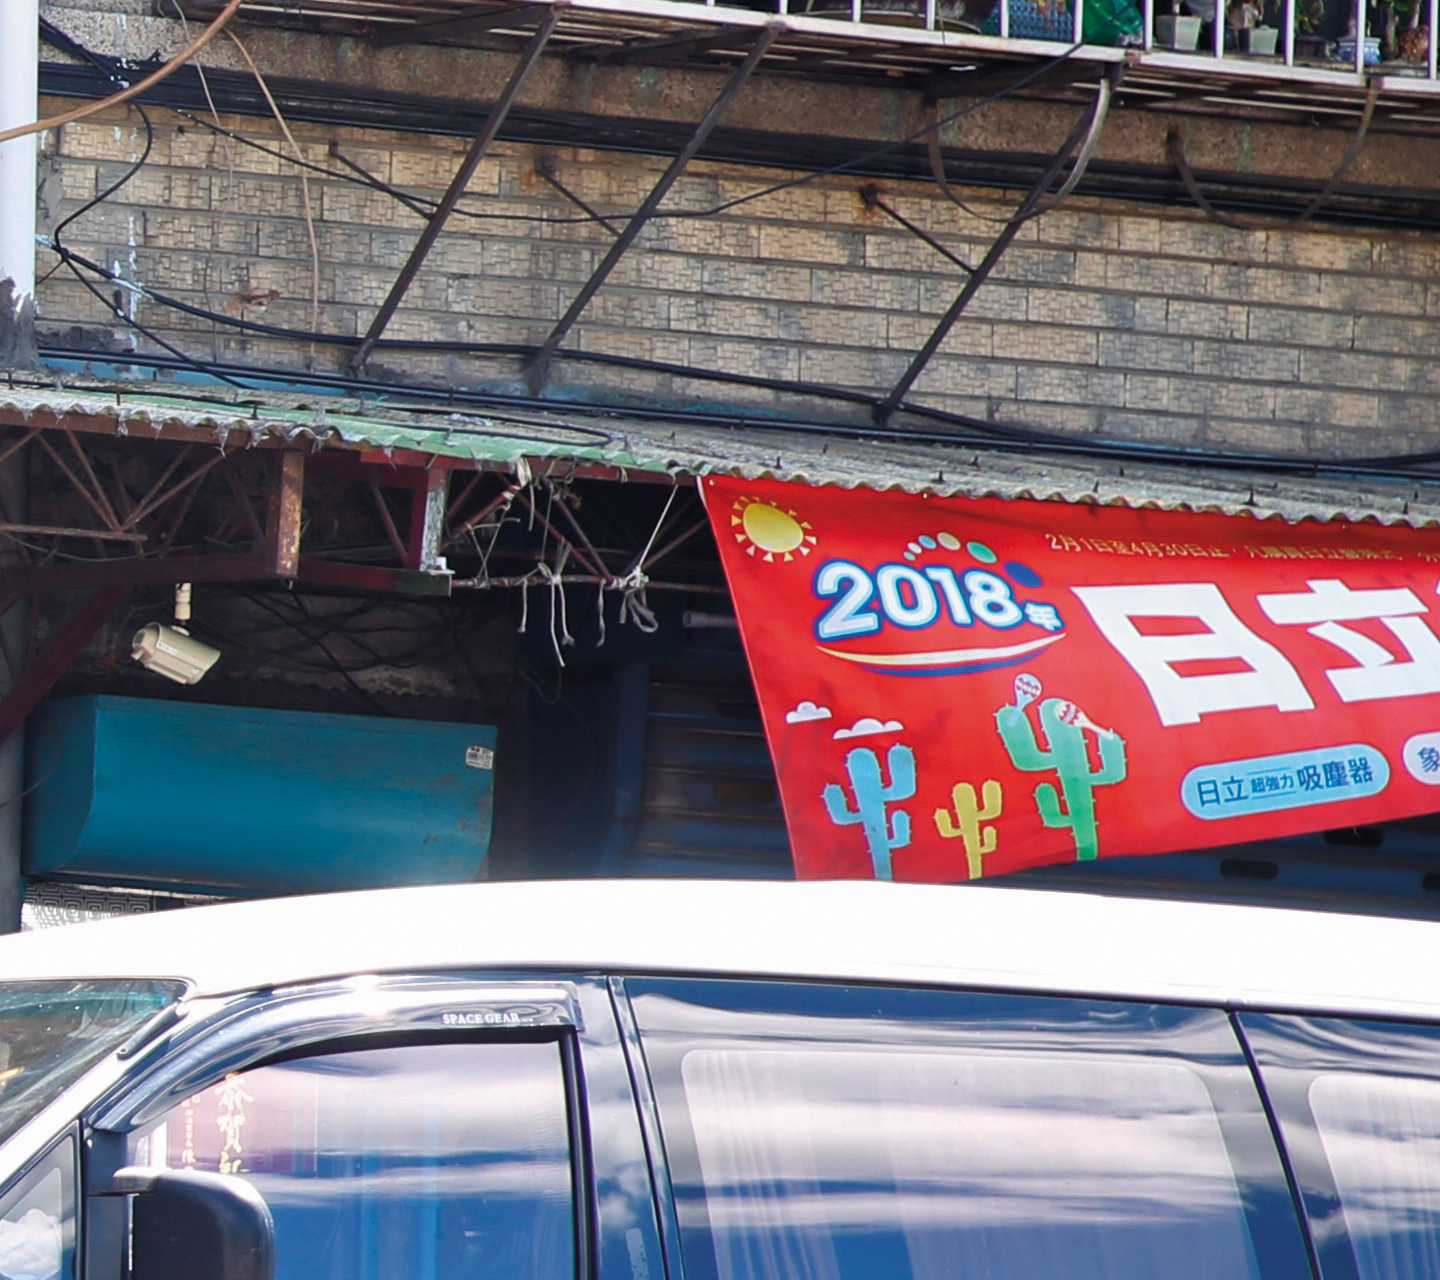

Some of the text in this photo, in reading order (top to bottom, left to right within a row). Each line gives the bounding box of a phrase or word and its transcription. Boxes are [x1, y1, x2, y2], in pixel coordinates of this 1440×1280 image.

[815, 558, 1066, 642] 2018年
[1070, 578, 1440, 727] 日立
[442, 1012, 521, 1025] SPACE GEAR
